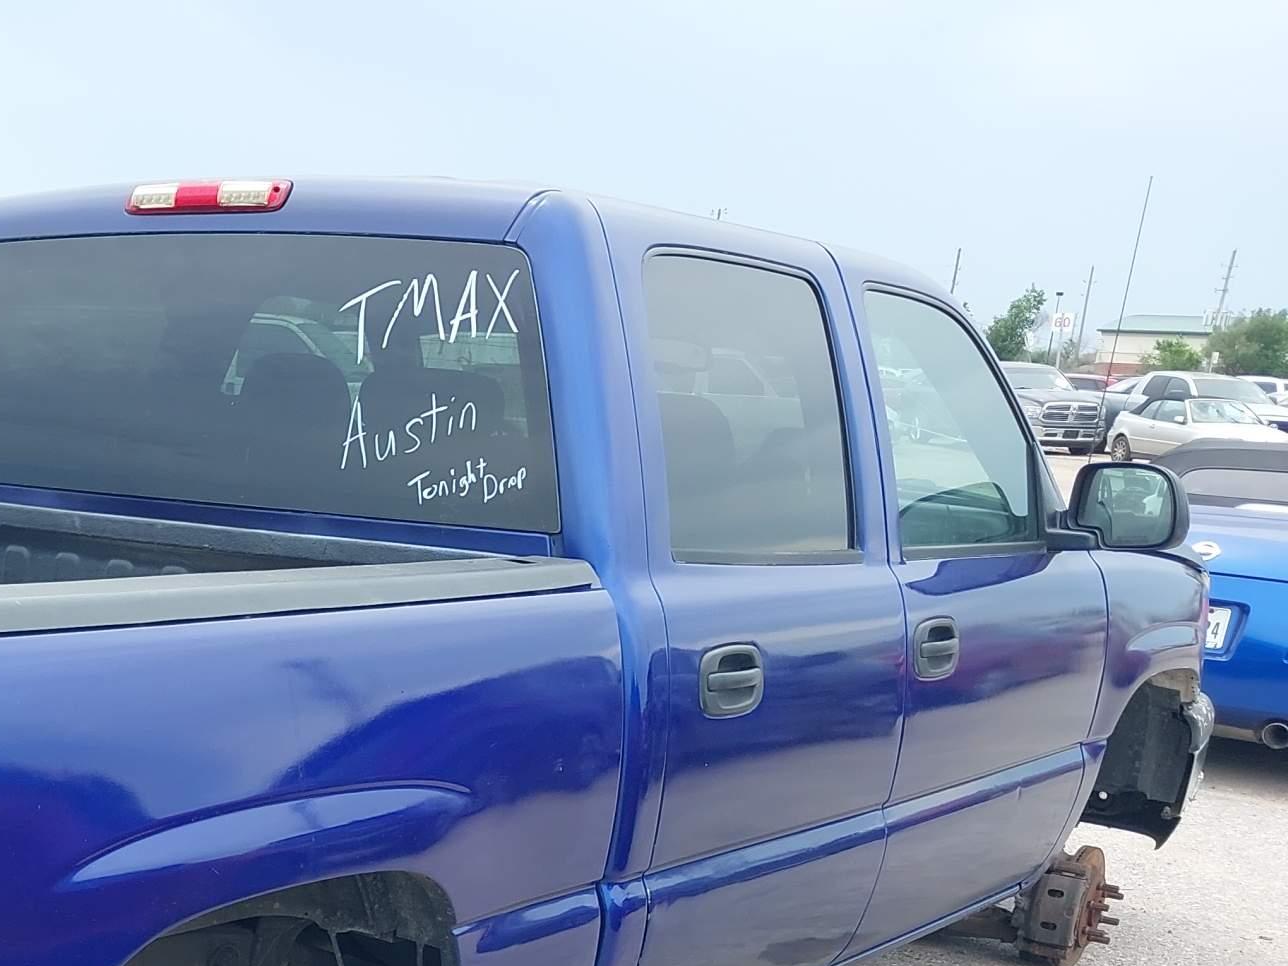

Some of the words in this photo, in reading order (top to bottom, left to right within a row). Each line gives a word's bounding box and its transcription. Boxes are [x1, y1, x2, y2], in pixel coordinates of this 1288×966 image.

[338, 269, 520, 365] TMAX
[340, 393, 478, 470] Austin
[407, 457, 487, 505] Tonight
[482, 466, 527, 503] Drop
